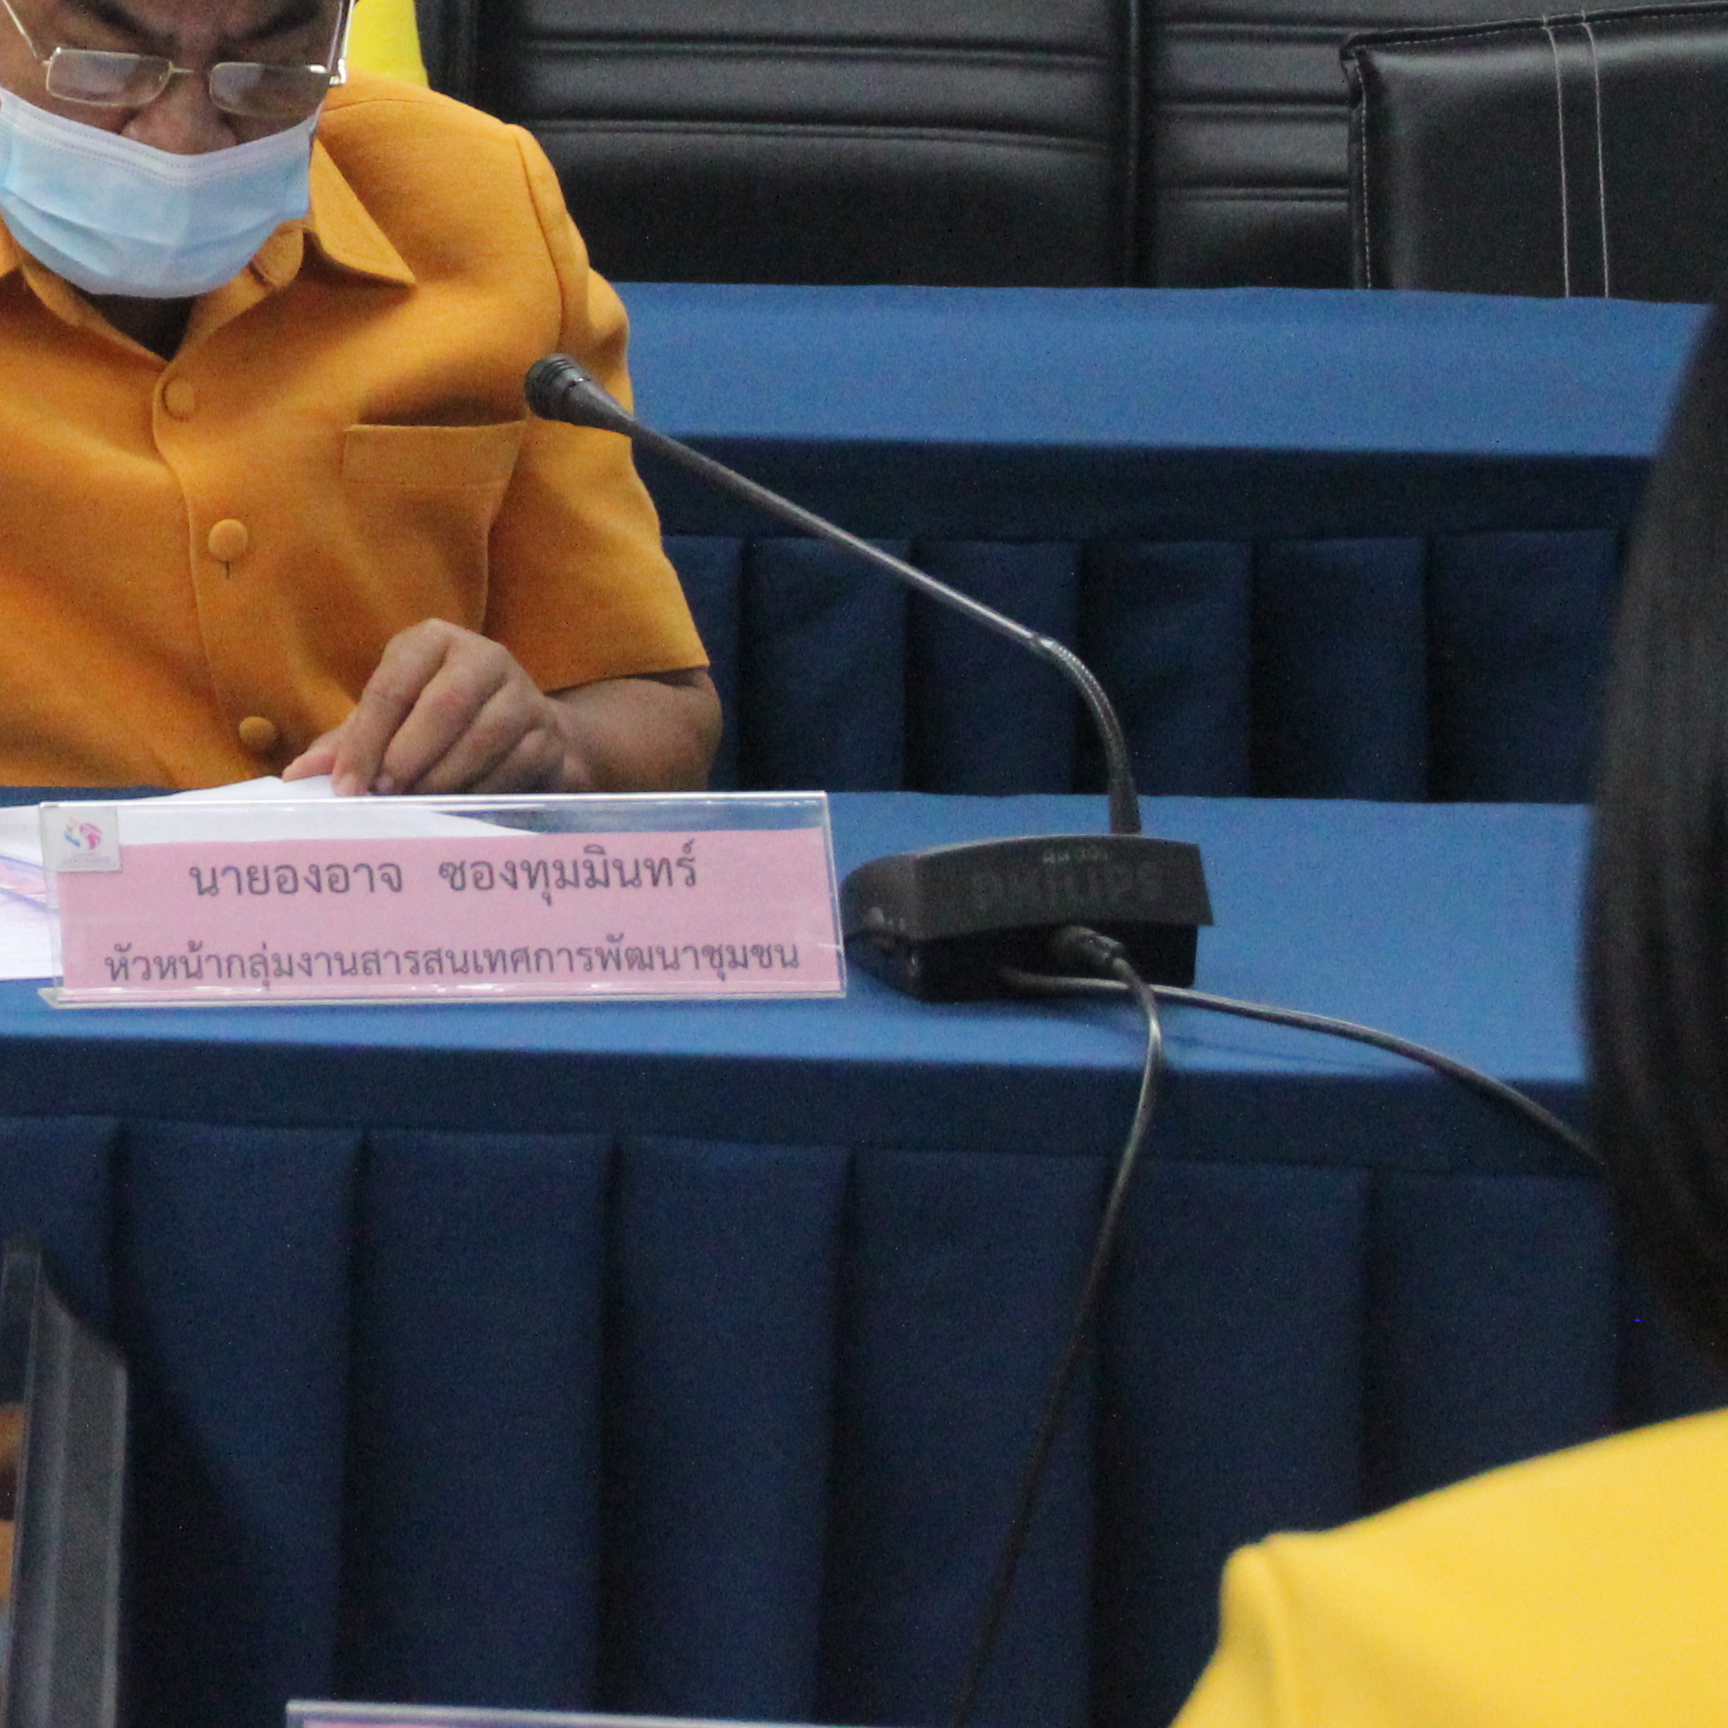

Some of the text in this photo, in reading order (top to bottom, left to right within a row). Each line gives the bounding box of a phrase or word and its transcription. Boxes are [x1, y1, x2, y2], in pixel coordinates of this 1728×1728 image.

[189, 860, 404, 897] นายองอาจ
[104, 932, 800, 990] หัวหน้ากลุ่มงานสารสนเทศการพัฒนาชุมชน
